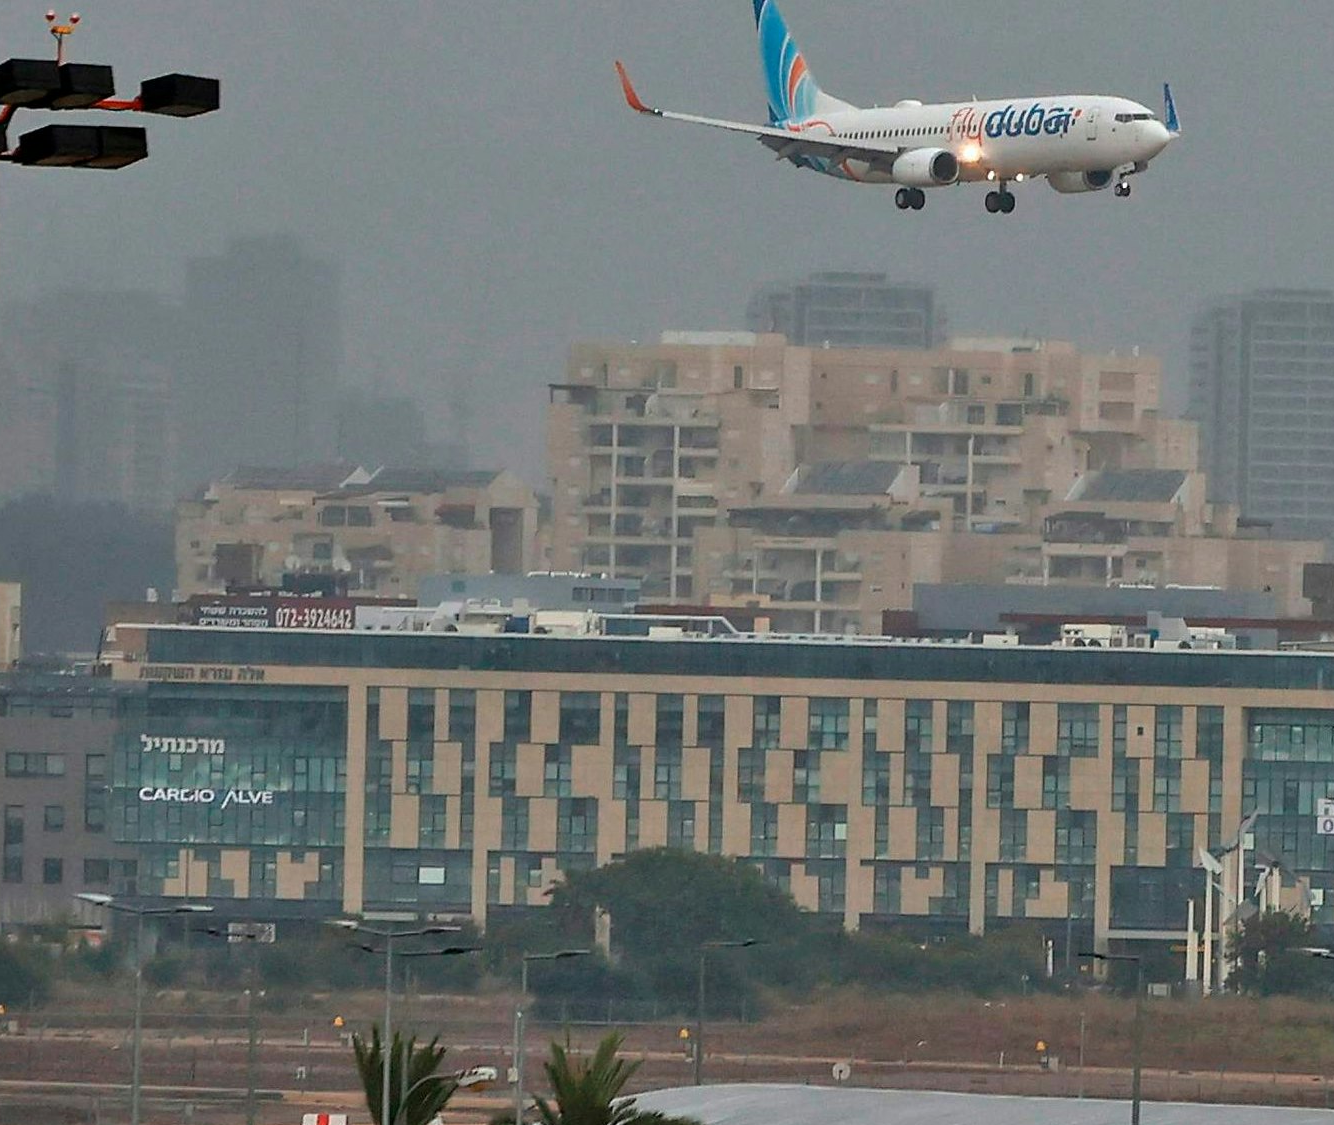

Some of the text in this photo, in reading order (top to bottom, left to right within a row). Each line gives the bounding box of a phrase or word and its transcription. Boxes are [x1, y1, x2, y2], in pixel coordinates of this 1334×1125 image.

[947, 103, 1083, 147] flydubai
[275, 607, 352, 629] 072-3924642
[140, 734, 226, 754] מרכנתיל
